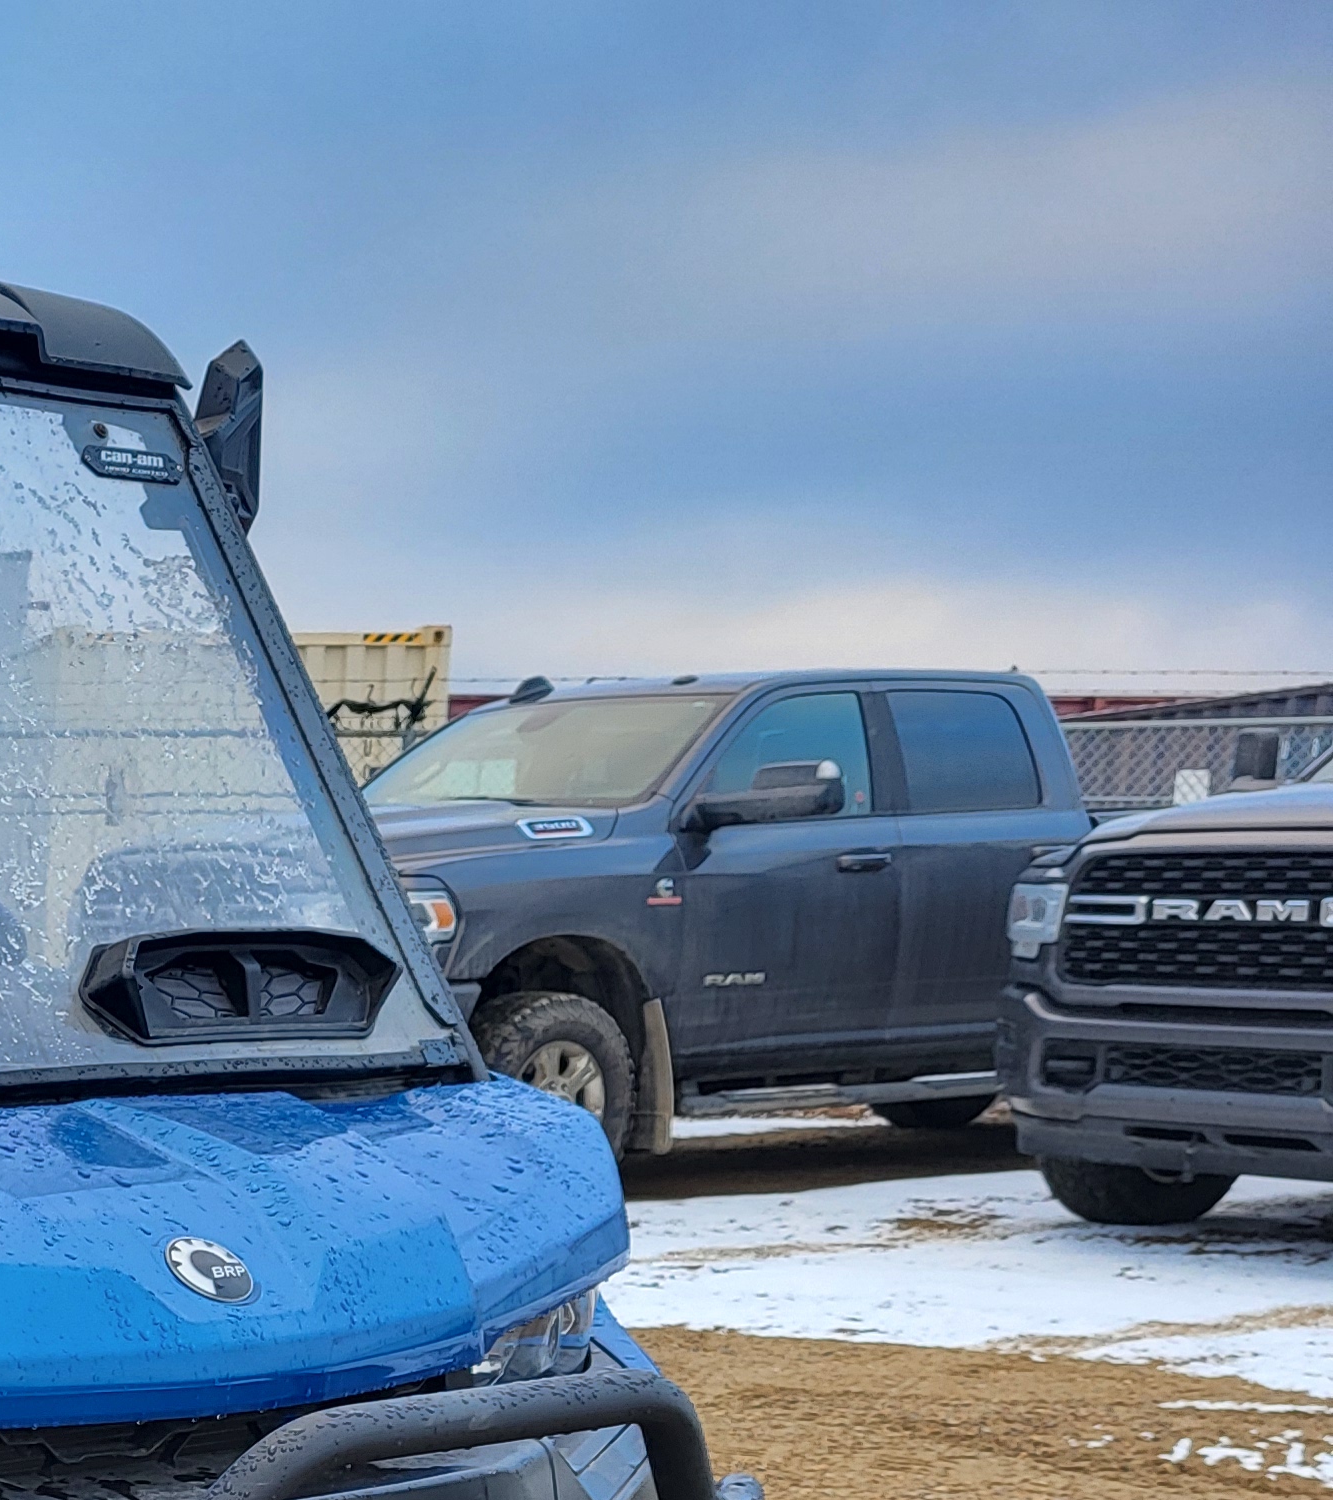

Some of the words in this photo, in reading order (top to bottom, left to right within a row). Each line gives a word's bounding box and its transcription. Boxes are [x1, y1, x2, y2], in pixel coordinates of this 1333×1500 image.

[100, 450, 164, 468] can-am
[1152, 898, 1311, 922] RAM
[703, 972, 766, 987] RAM
[211, 1265, 245, 1279] BRP
